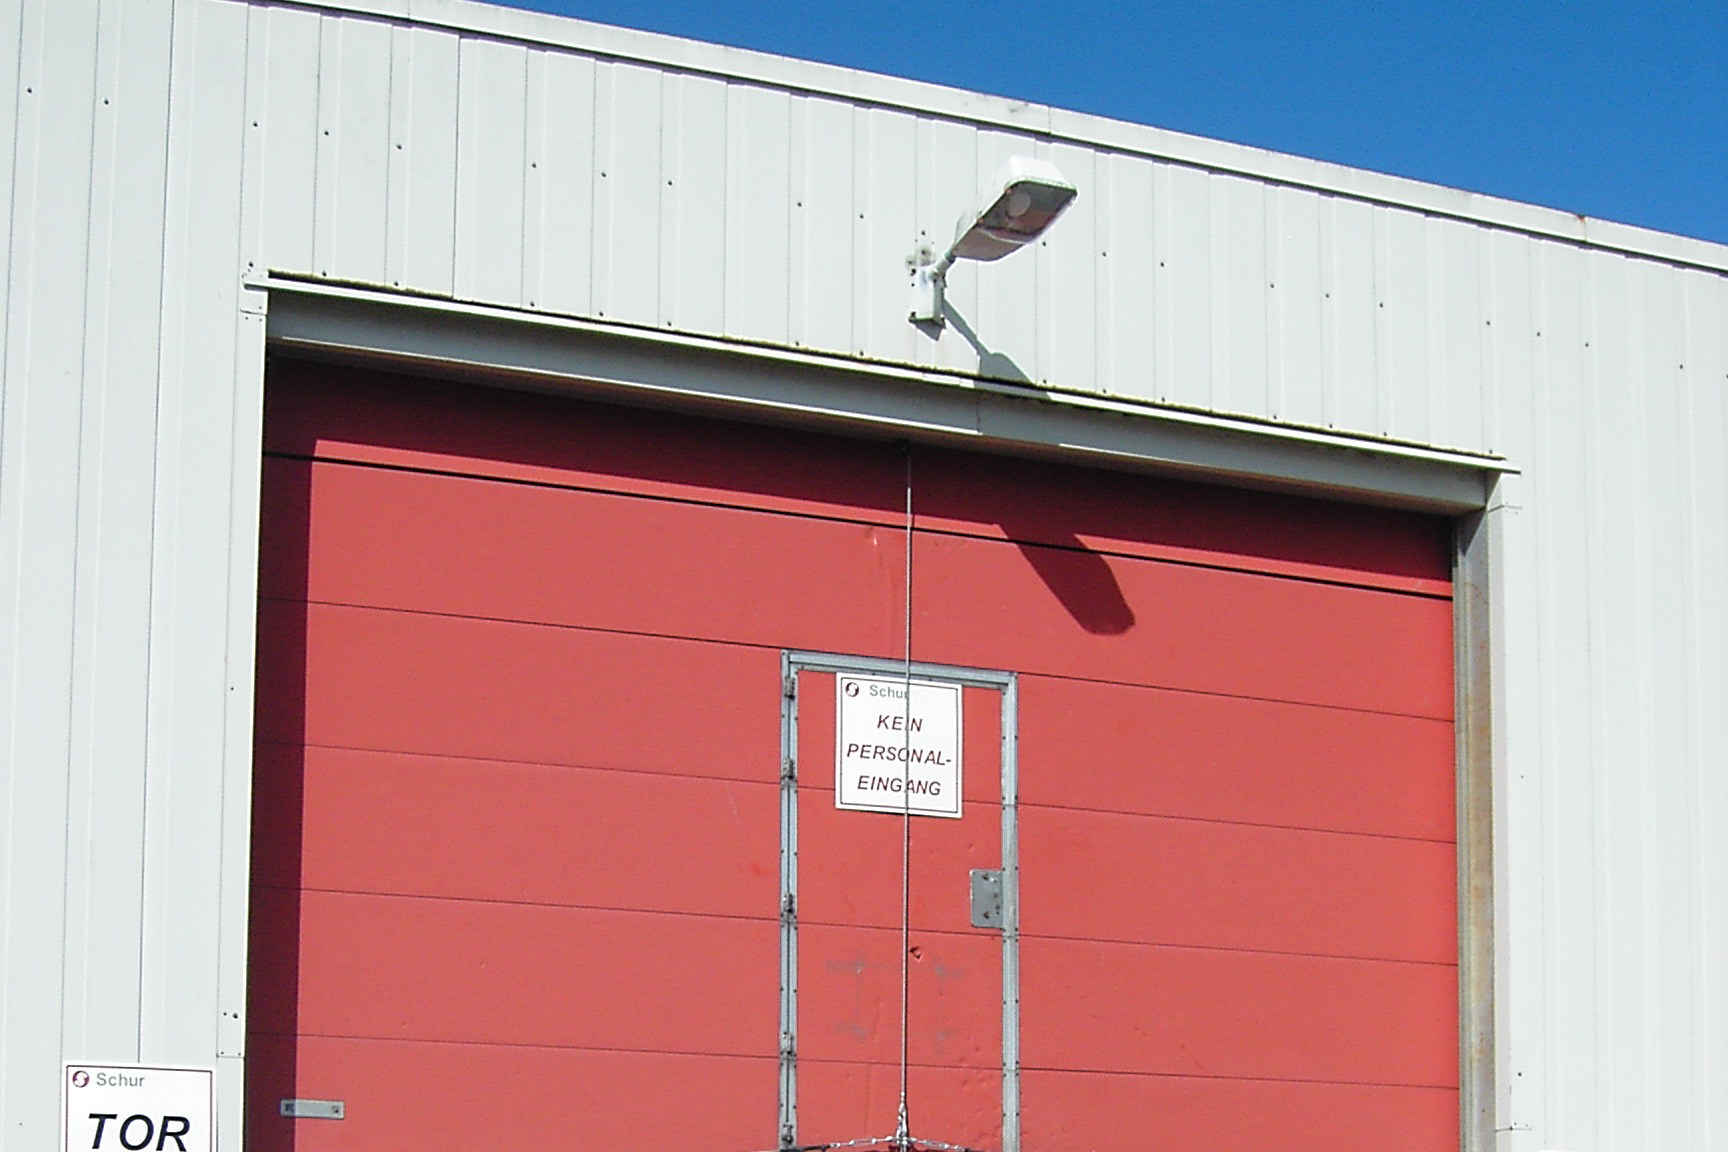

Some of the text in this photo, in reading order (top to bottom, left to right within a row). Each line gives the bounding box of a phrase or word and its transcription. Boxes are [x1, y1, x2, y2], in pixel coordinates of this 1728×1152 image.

[877, 714, 923, 732] KEN
[847, 743, 952, 766] PERSONAL-
[857, 775, 941, 797] EINGANG
[96, 1072, 145, 1087] Schur
[88, 1113, 191, 1152] TOR
